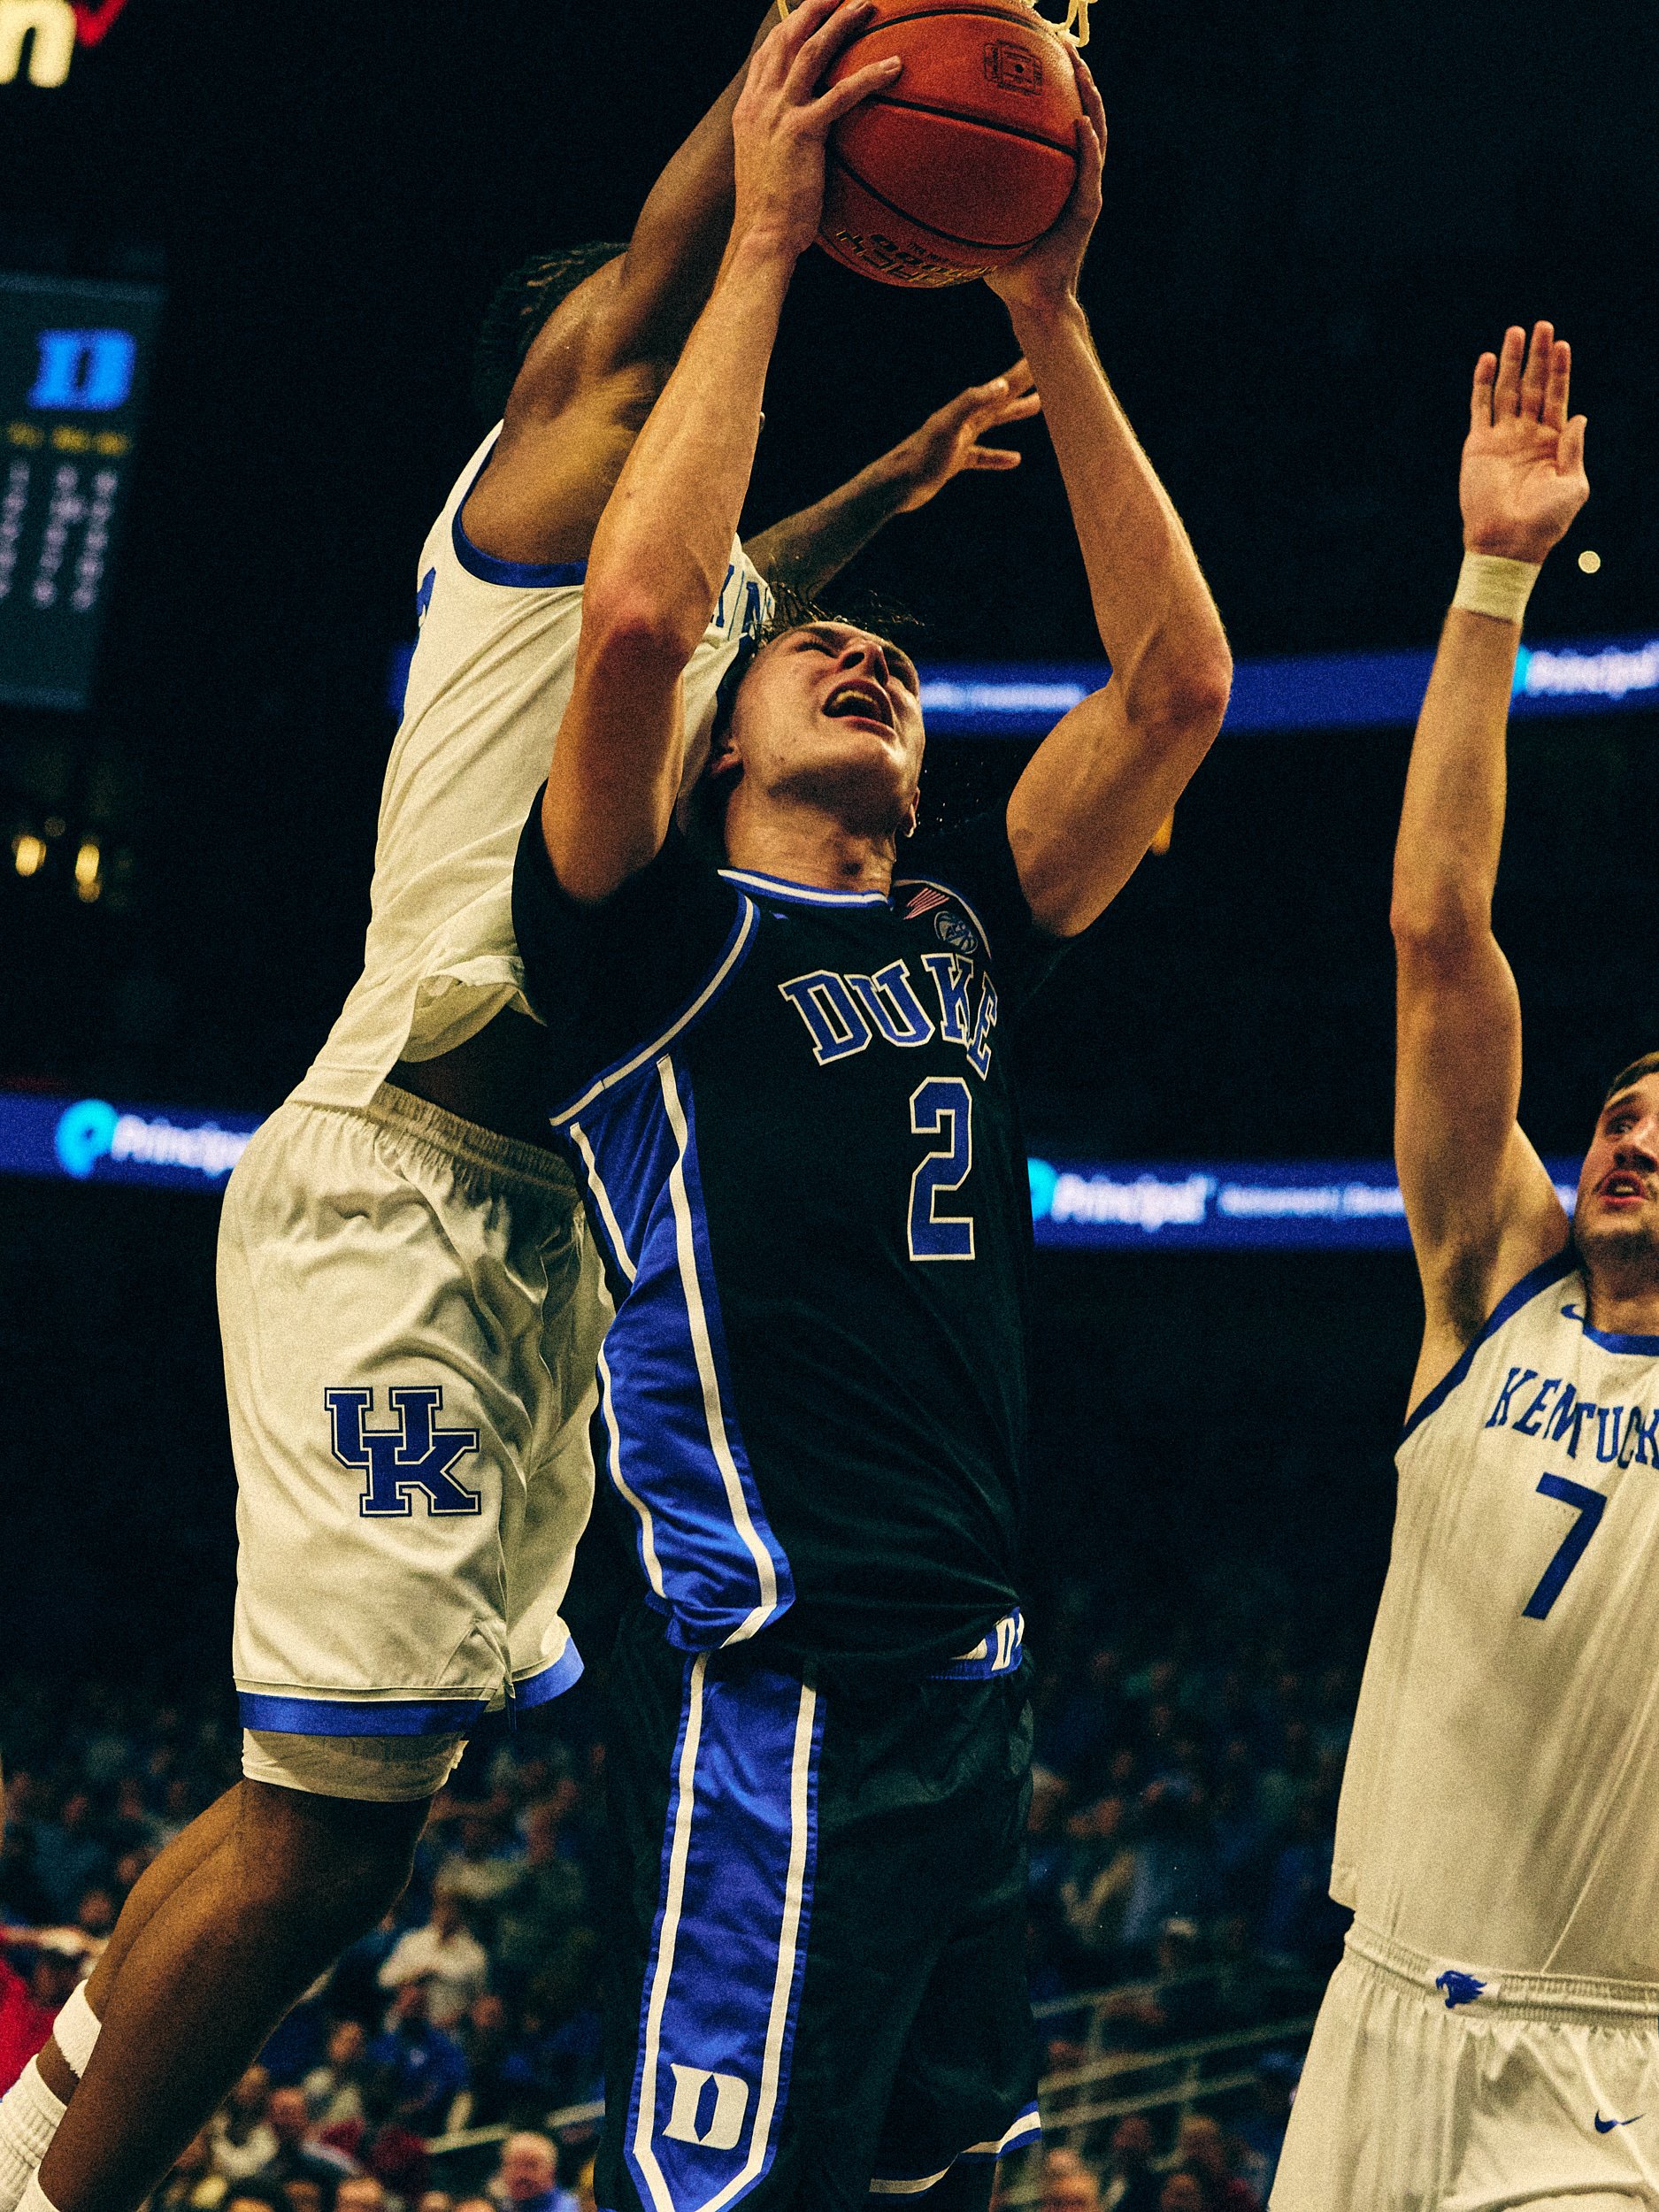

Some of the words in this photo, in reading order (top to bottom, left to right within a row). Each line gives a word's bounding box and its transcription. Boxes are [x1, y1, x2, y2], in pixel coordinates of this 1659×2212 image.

[779, 952, 998, 1081] DUKE
[907, 1076, 976, 1261] 2
[324, 1385, 482, 1517] UK
[1521, 1471, 1608, 1621] 7
[662, 2062, 749, 2150] D
